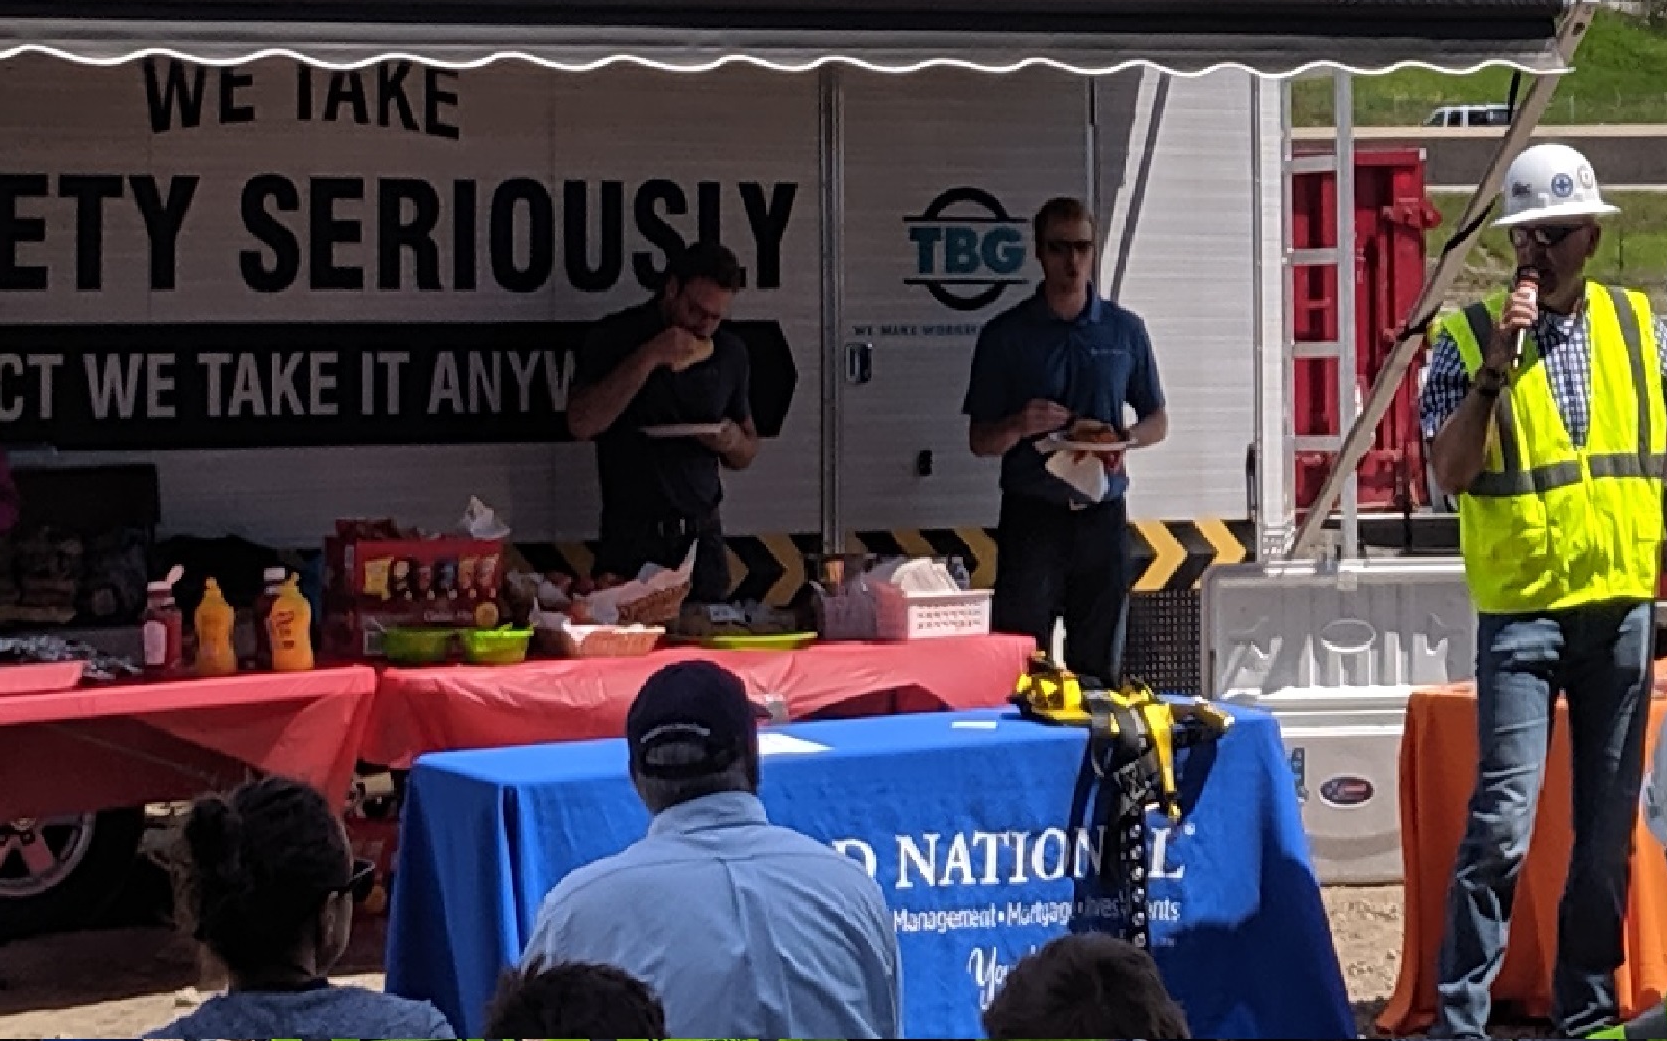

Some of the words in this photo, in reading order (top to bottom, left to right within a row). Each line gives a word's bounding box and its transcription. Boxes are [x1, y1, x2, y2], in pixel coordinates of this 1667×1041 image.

[143, 59, 255, 133] WE
[297, 61, 459, 141] TAKE
[239, 173, 799, 293] SERIOUSLY
[909, 226, 1026, 274] TBG
[84, 353, 176, 421] WE
[198, 351, 338, 418] TAKE
[361, 351, 410, 417] IT
[427, 349, 578, 414] ANYW
[895, 826, 1185, 888] NATIONL
[894, 903, 995, 933] Management
[1007, 896, 1072, 927] Mortgag
[1086, 890, 1180, 923] Invesnts
